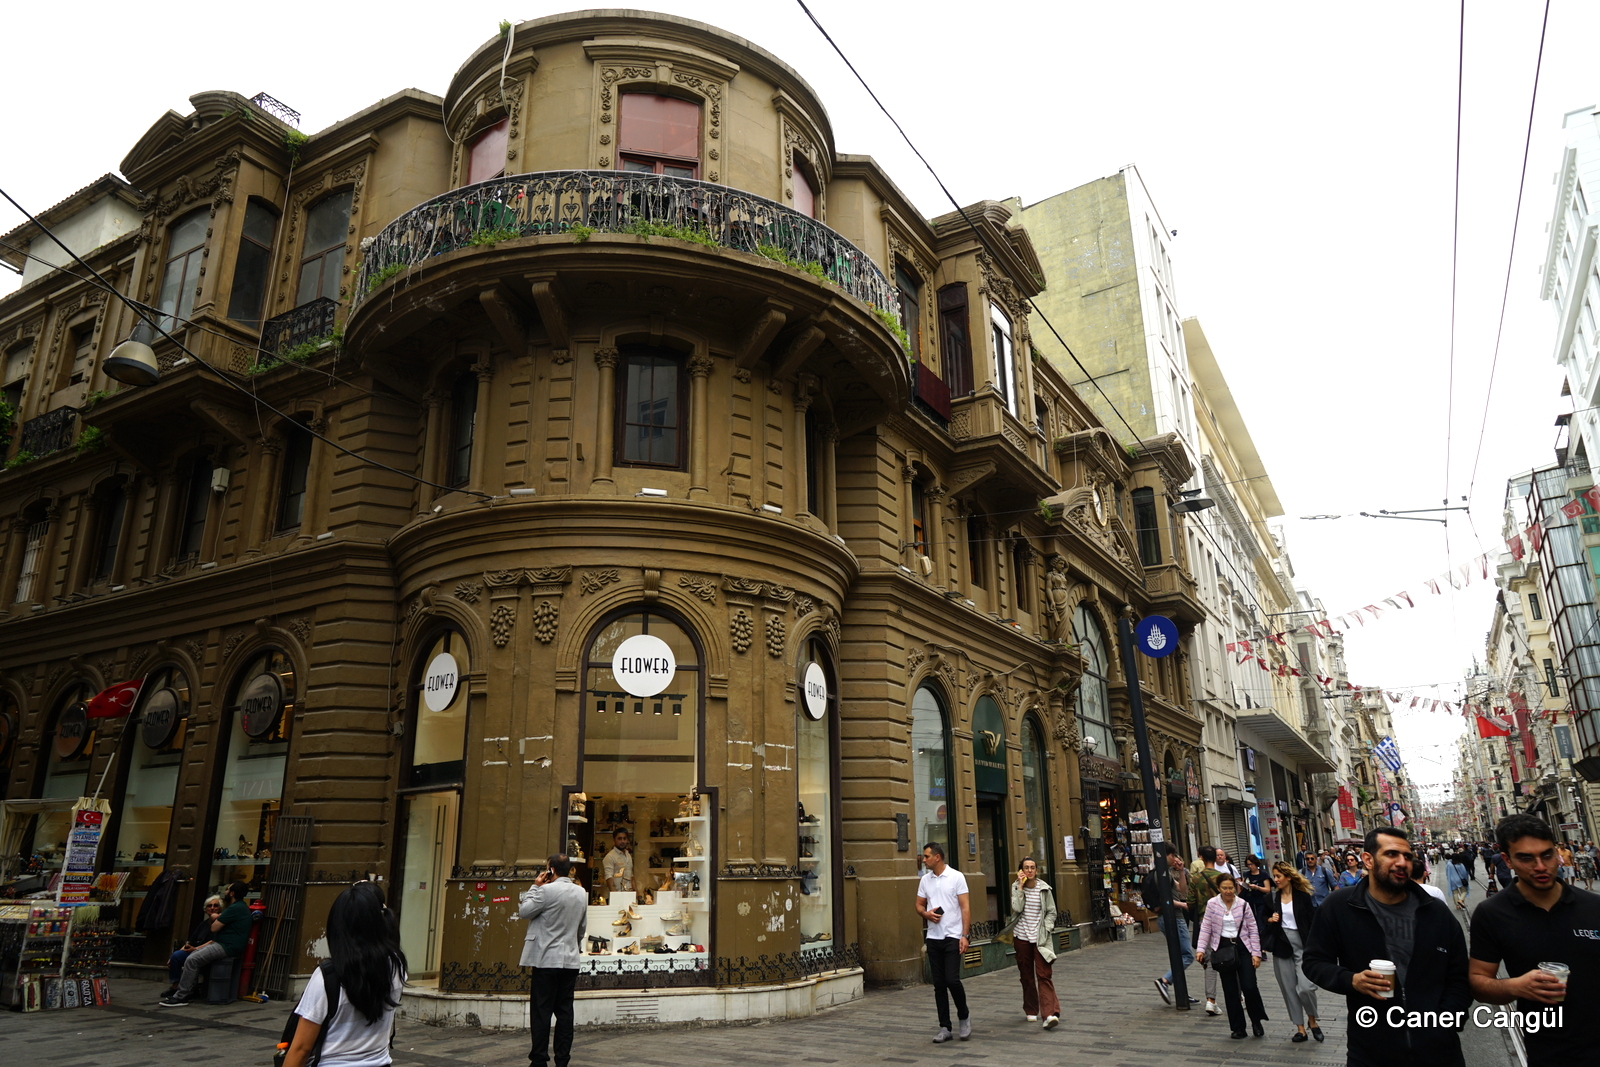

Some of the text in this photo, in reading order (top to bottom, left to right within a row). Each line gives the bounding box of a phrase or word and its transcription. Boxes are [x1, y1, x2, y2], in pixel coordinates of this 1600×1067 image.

[620, 657, 670, 674] FLOWER
[427, 673, 455, 692] FLOWER
[808, 681, 825, 700] FLOWER
[245, 695, 273, 714] FLOWER
[146, 710, 170, 727] FLOWER
[60, 722, 81, 739] FLOWER
